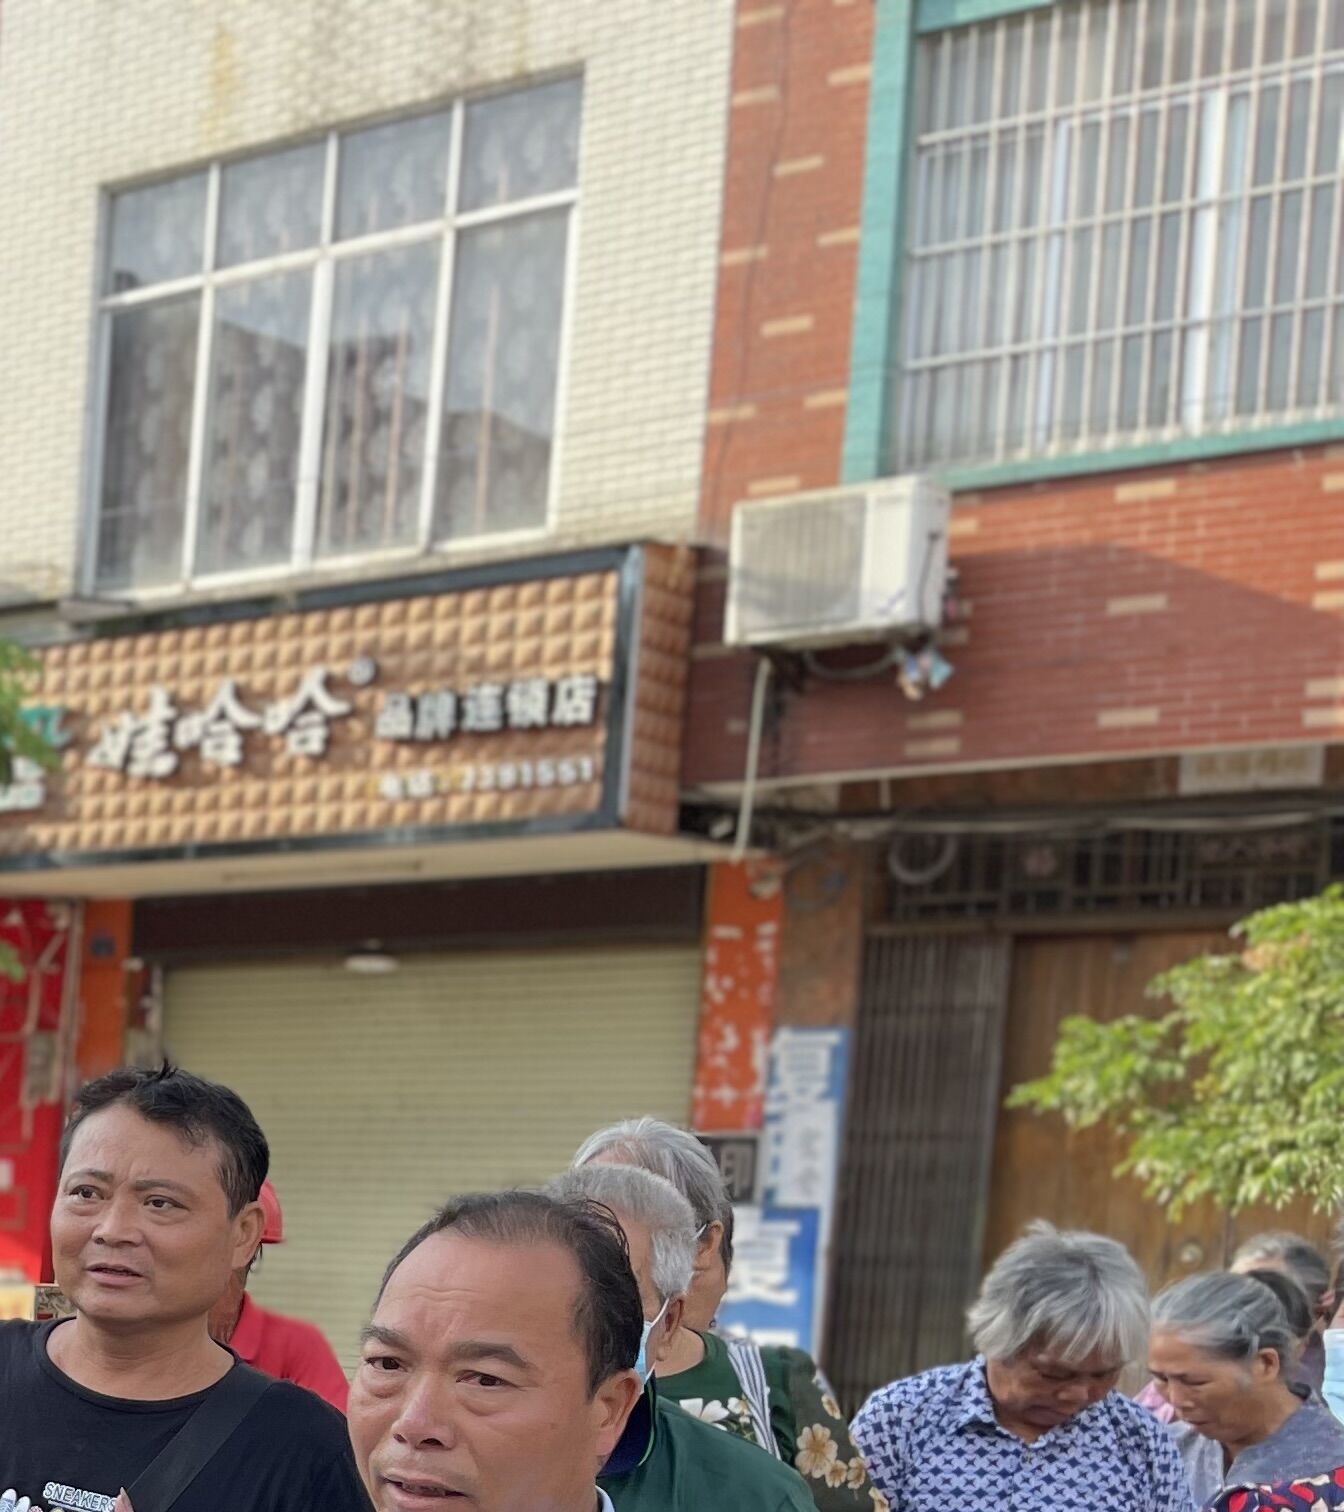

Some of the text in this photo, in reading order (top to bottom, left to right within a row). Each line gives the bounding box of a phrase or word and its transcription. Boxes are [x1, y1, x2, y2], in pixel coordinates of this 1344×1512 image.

[375, 674, 598, 741] 品牌连锁店
